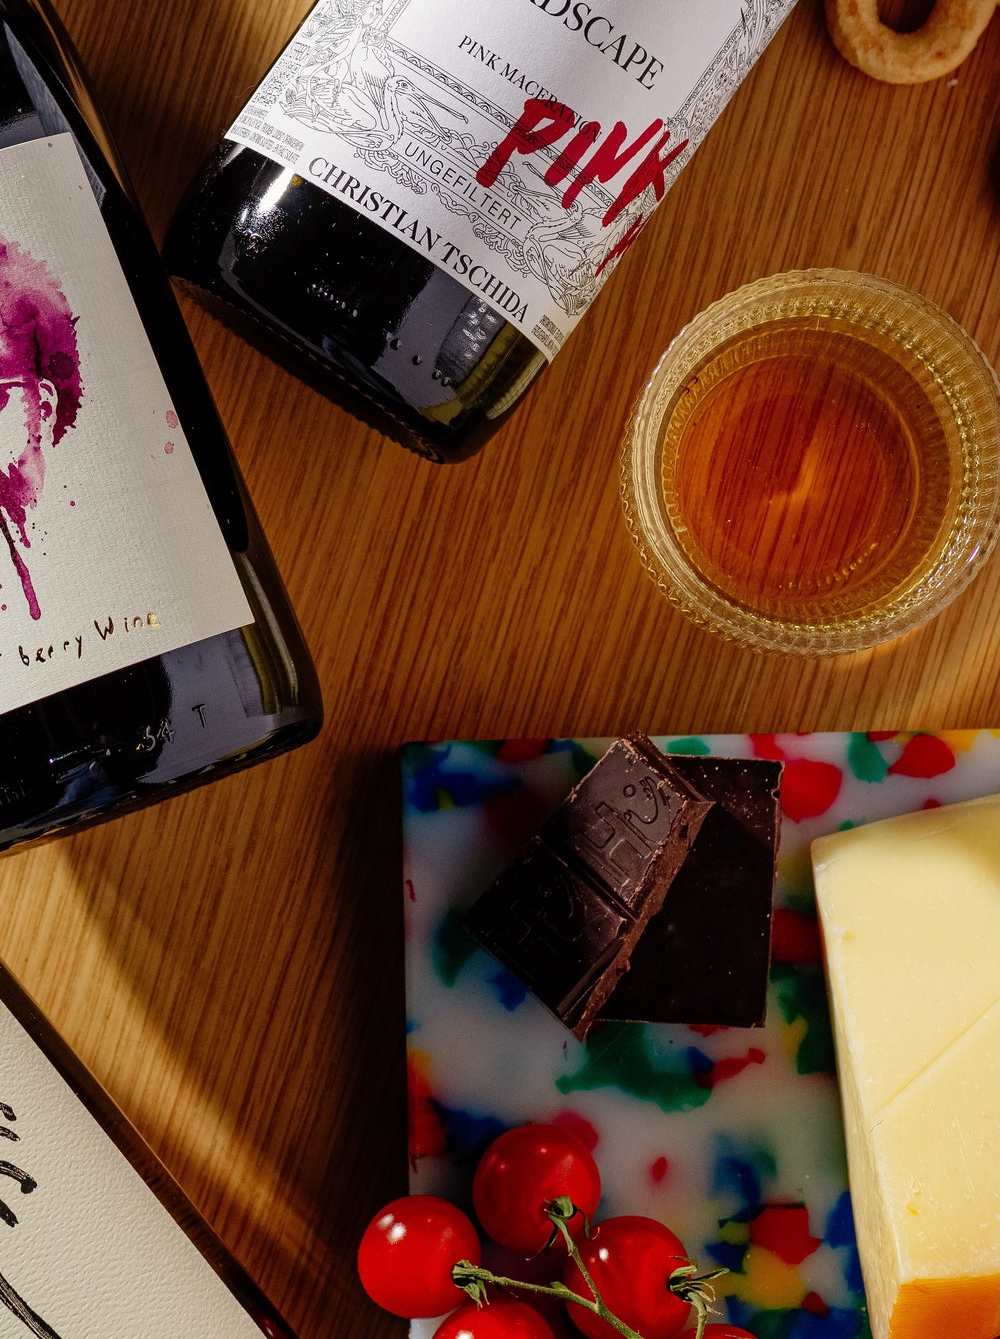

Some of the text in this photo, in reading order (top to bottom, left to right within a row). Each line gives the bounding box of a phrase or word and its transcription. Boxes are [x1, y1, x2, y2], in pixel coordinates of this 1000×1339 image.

[457, 34, 603, 144] PINK MACERATION
[404, 141, 522, 230] UNGEFILTERT
[476, 97, 690, 228] PINK
[308, 156, 443, 252] CHRISTIAN
[440, 241, 530, 324] TSCHIDA
[94, 612, 161, 640] Wine
